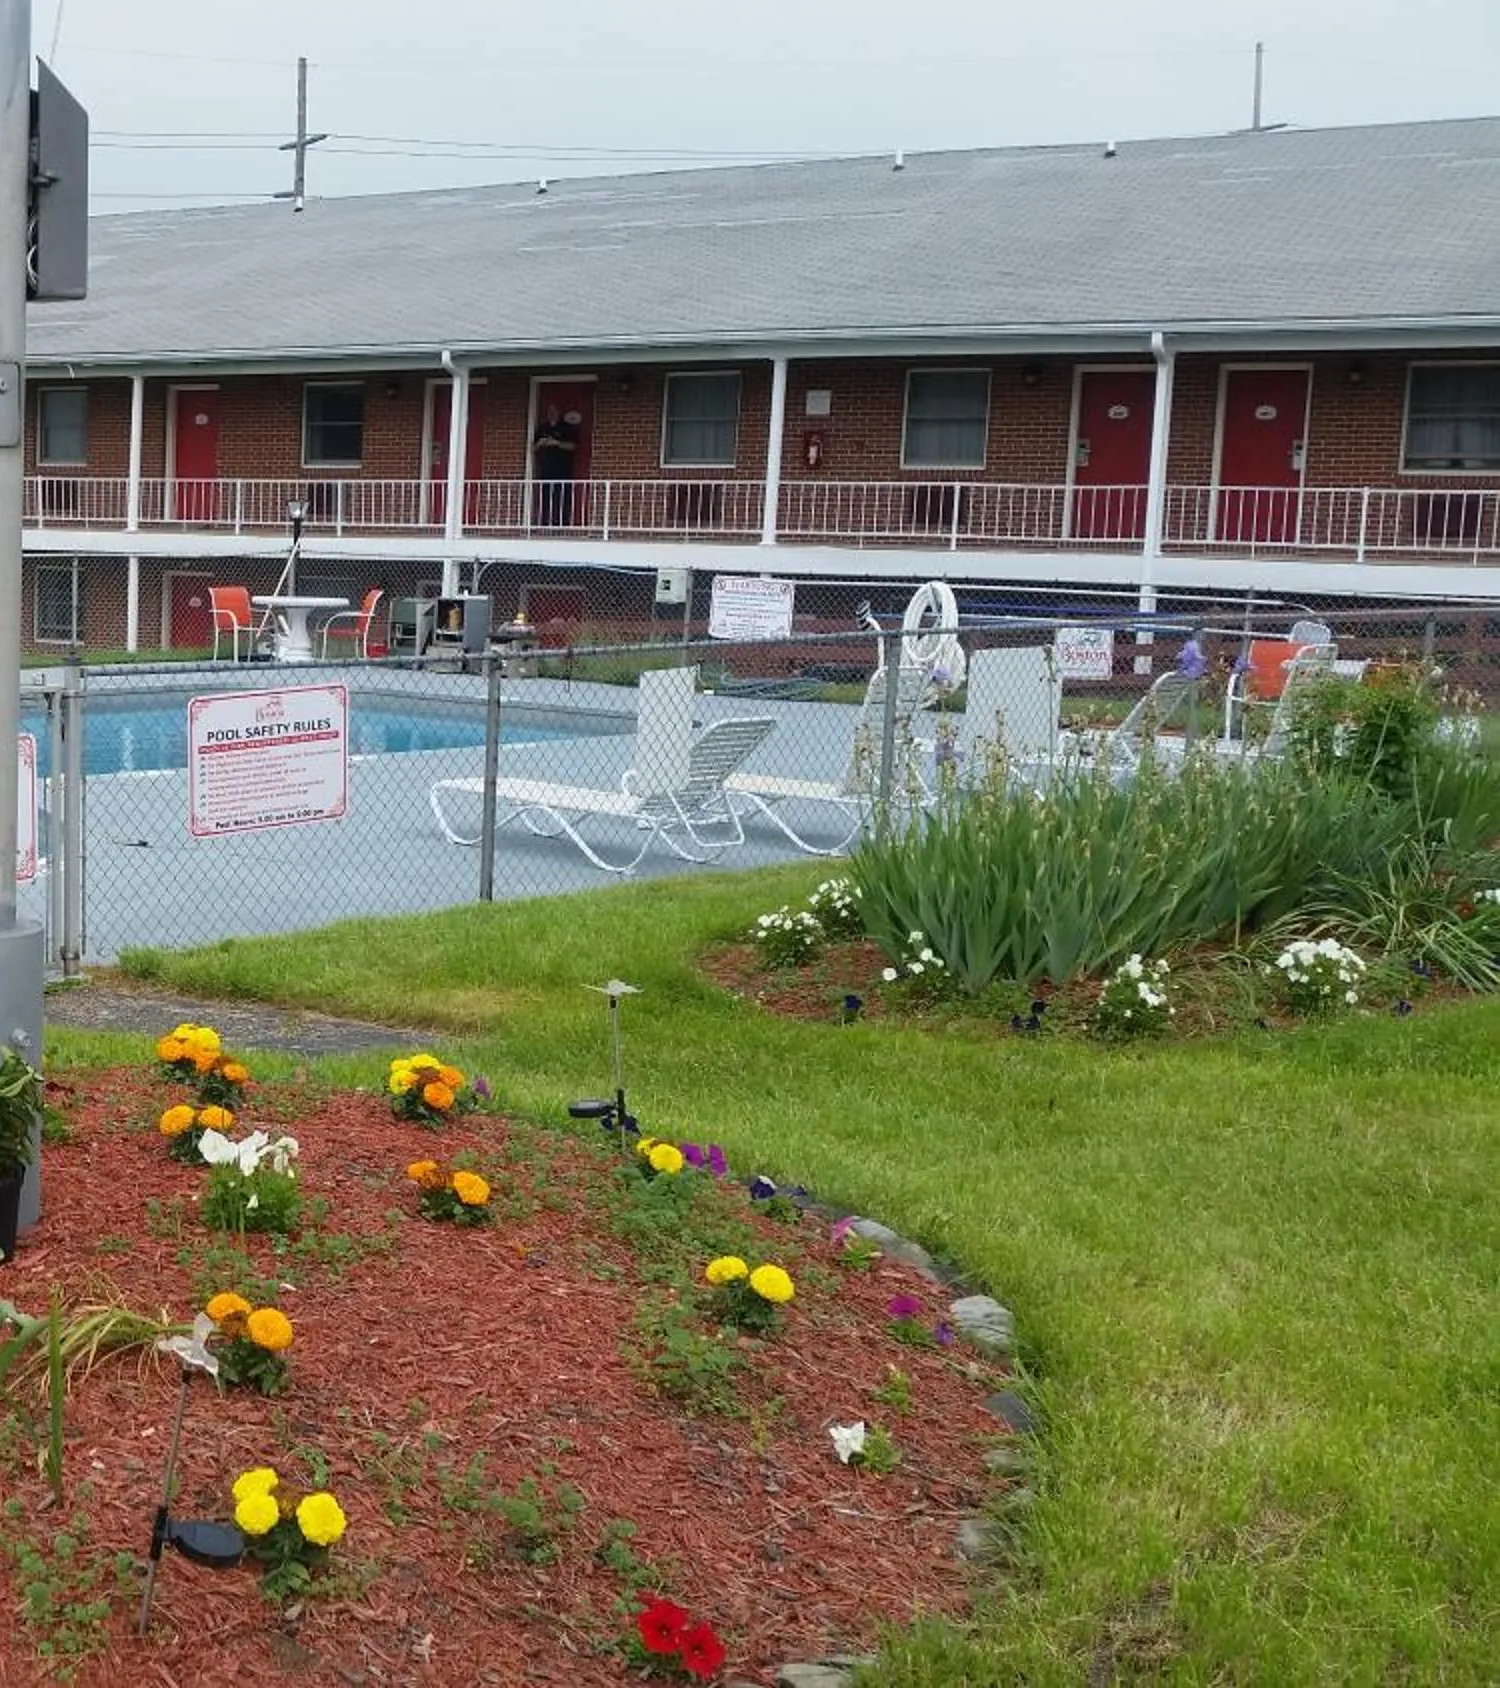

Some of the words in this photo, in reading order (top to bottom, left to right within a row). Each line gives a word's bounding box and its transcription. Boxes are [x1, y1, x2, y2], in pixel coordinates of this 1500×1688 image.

[207, 729, 242, 742] POOL
[245, 722, 291, 738] SAFETY
[294, 717, 331, 732] RULES
